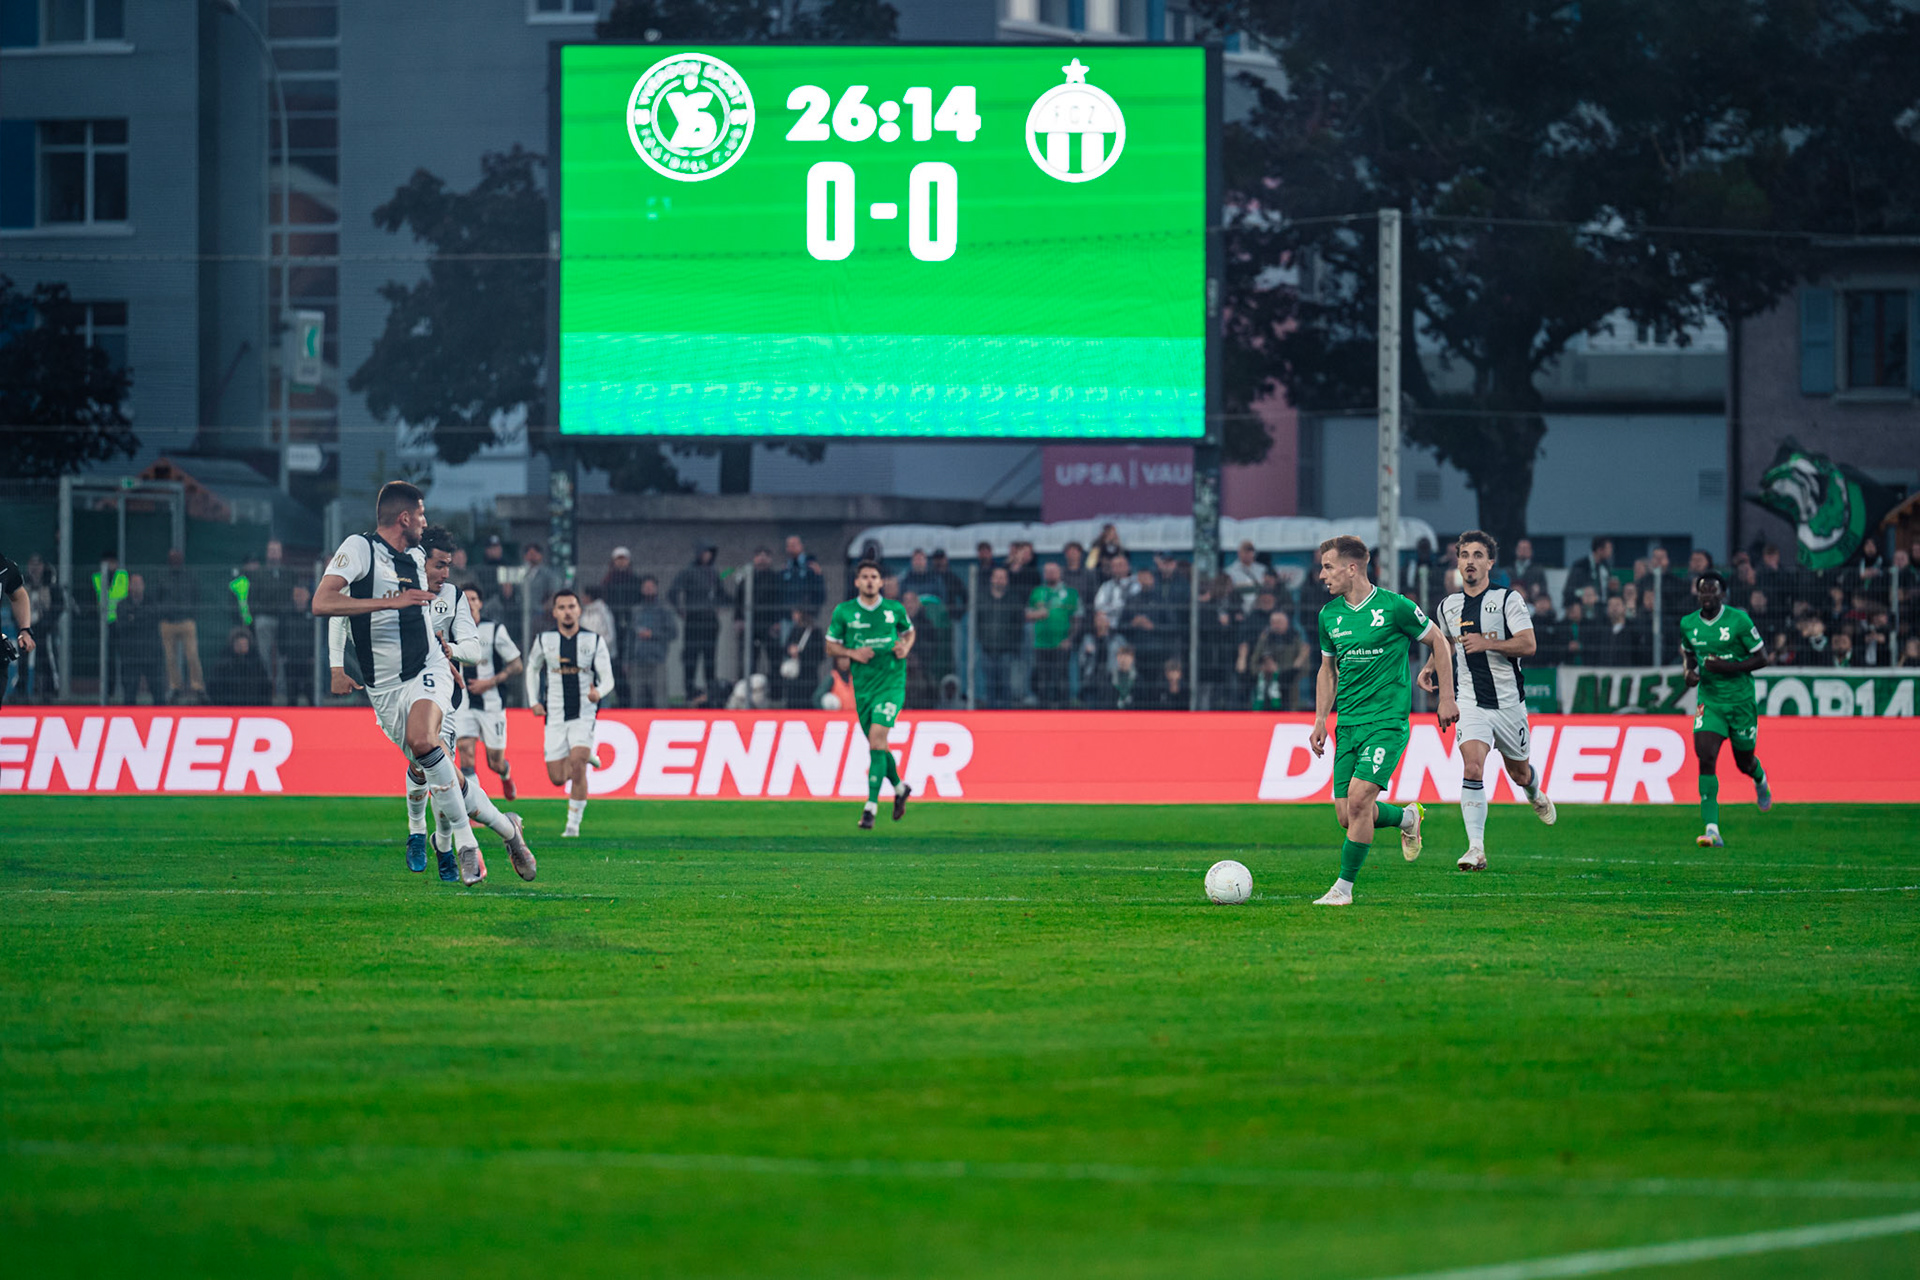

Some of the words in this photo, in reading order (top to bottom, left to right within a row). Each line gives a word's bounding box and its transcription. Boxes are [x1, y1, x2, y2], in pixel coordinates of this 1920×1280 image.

[785, 84, 982, 143] 26:14
[806, 161, 958, 261] 0-0
[1055, 462, 1126, 487] UPSA
[1141, 462, 1193, 487] VAU
[422, 673, 435, 688] 5
[0, 716, 294, 792] ENNER
[1372, 746, 1386, 765] 8
[1518, 727, 1527, 748] 2
[1257, 722, 1687, 804] DNNER
